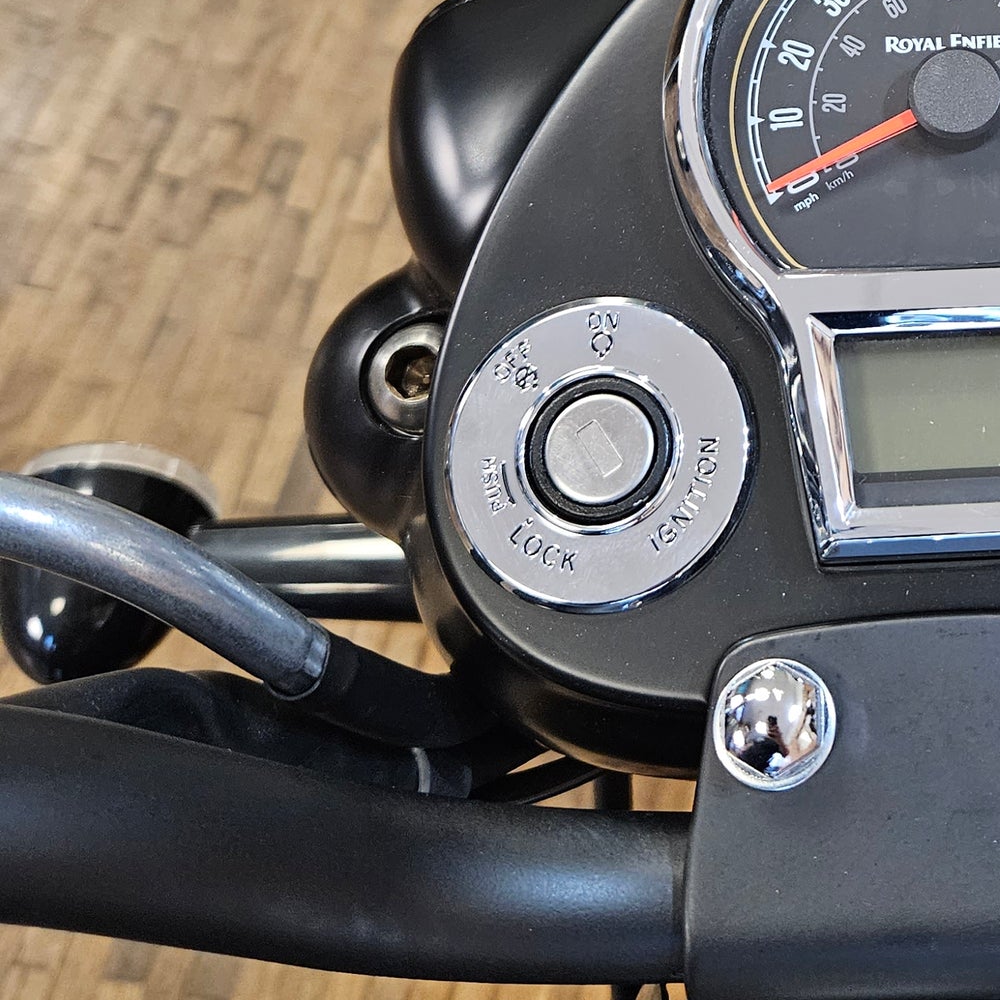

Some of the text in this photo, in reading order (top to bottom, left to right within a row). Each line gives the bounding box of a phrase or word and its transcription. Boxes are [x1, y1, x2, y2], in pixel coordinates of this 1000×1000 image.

[777, 39, 815, 71] 20
[838, 34, 866, 58] 40
[885, 35, 946, 53] ROYAL
[821, 93, 847, 113] 20
[769, 107, 804, 131] 10
[786, 170, 820, 194] 0
[825, 170, 855, 191] km/h
[793, 192, 820, 212] mph
[586, 310, 621, 331] ON
[493, 338, 532, 383] OFF
[481, 456, 506, 516] PUSH
[648, 436, 721, 552] IGNITION
[508, 520, 578, 574] LOCK
